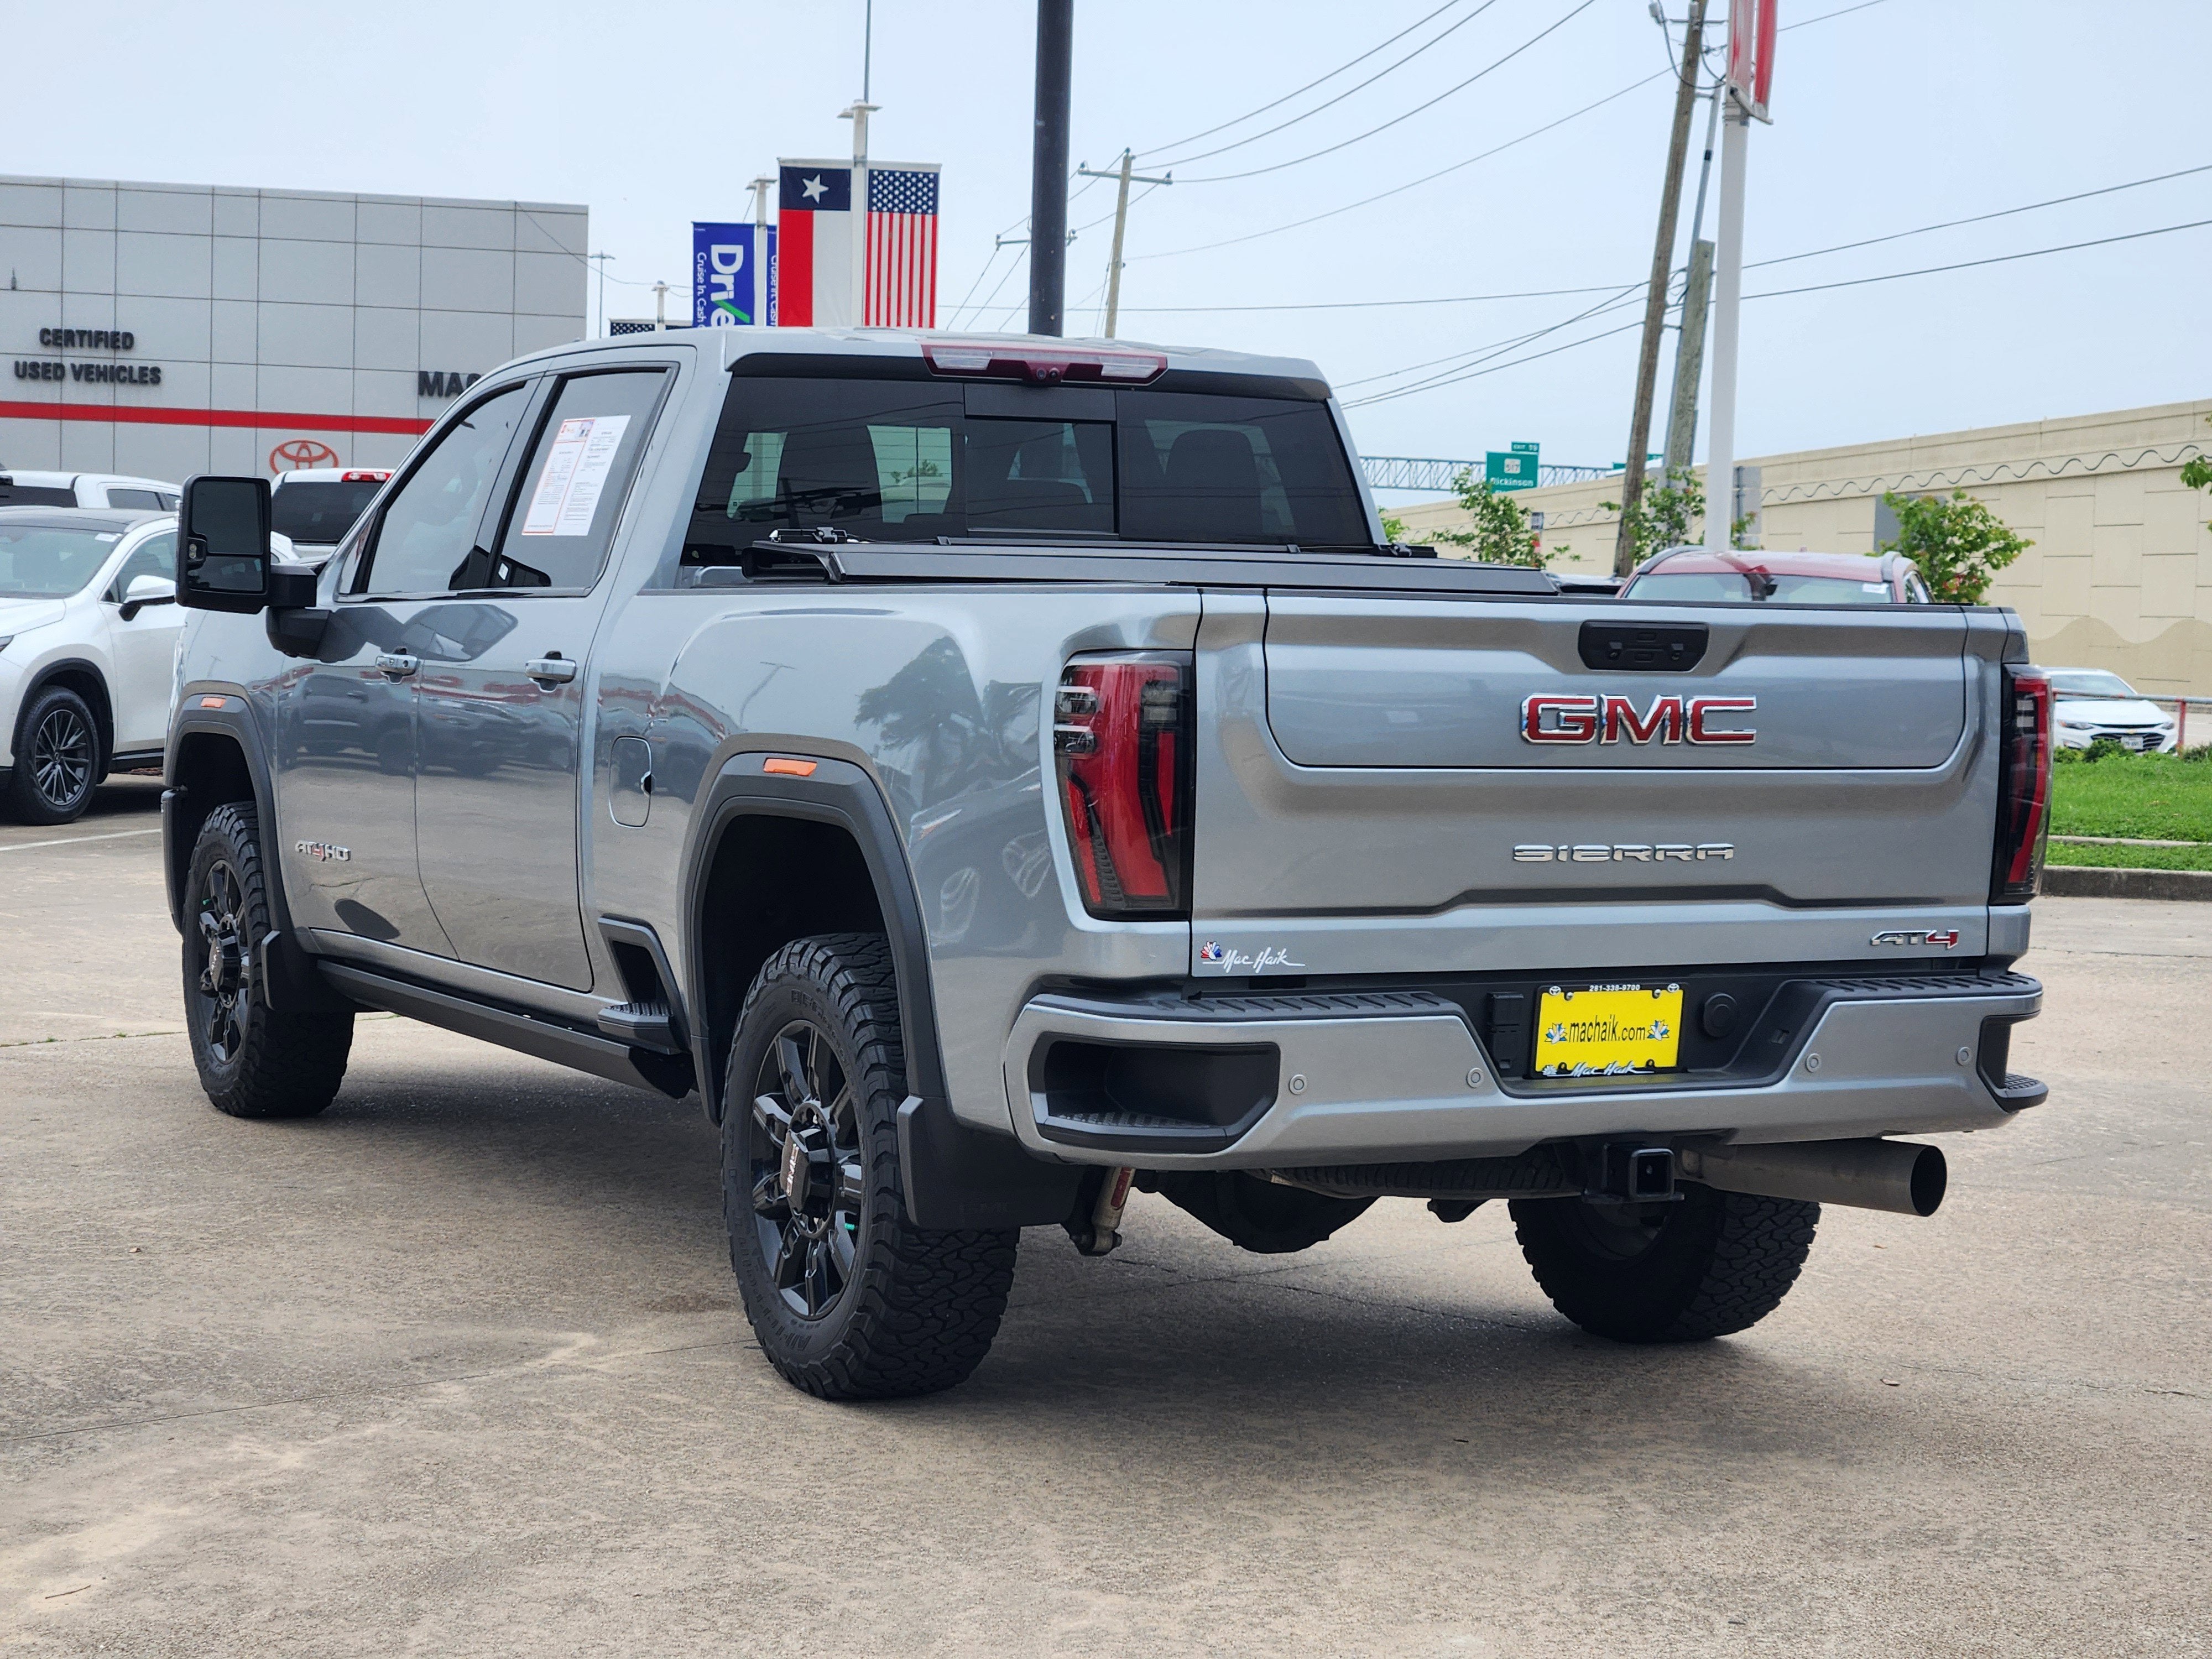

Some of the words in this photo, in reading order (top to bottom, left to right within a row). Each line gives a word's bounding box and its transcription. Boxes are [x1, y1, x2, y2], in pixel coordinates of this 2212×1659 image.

[697, 252, 707, 284] Cruise
[697, 285, 706, 296] In
[697, 298, 707, 322] Cash
[39, 327, 134, 350] CERTIFIED
[14, 361, 65, 380] USED
[70, 363, 161, 385] VEHICLES
[1520, 693, 1757, 746] GMC
[1512, 843, 1735, 862] SIERRA
[1870, 930, 1959, 949] AT4
[1220, 949, 1254, 973] Mac
[1253, 947, 1297, 973] Haik
[1569, 1014, 1646, 1042] machaik.com
[1571, 1062, 1603, 1077] Mac
[1604, 1061, 1645, 1076] Haik
